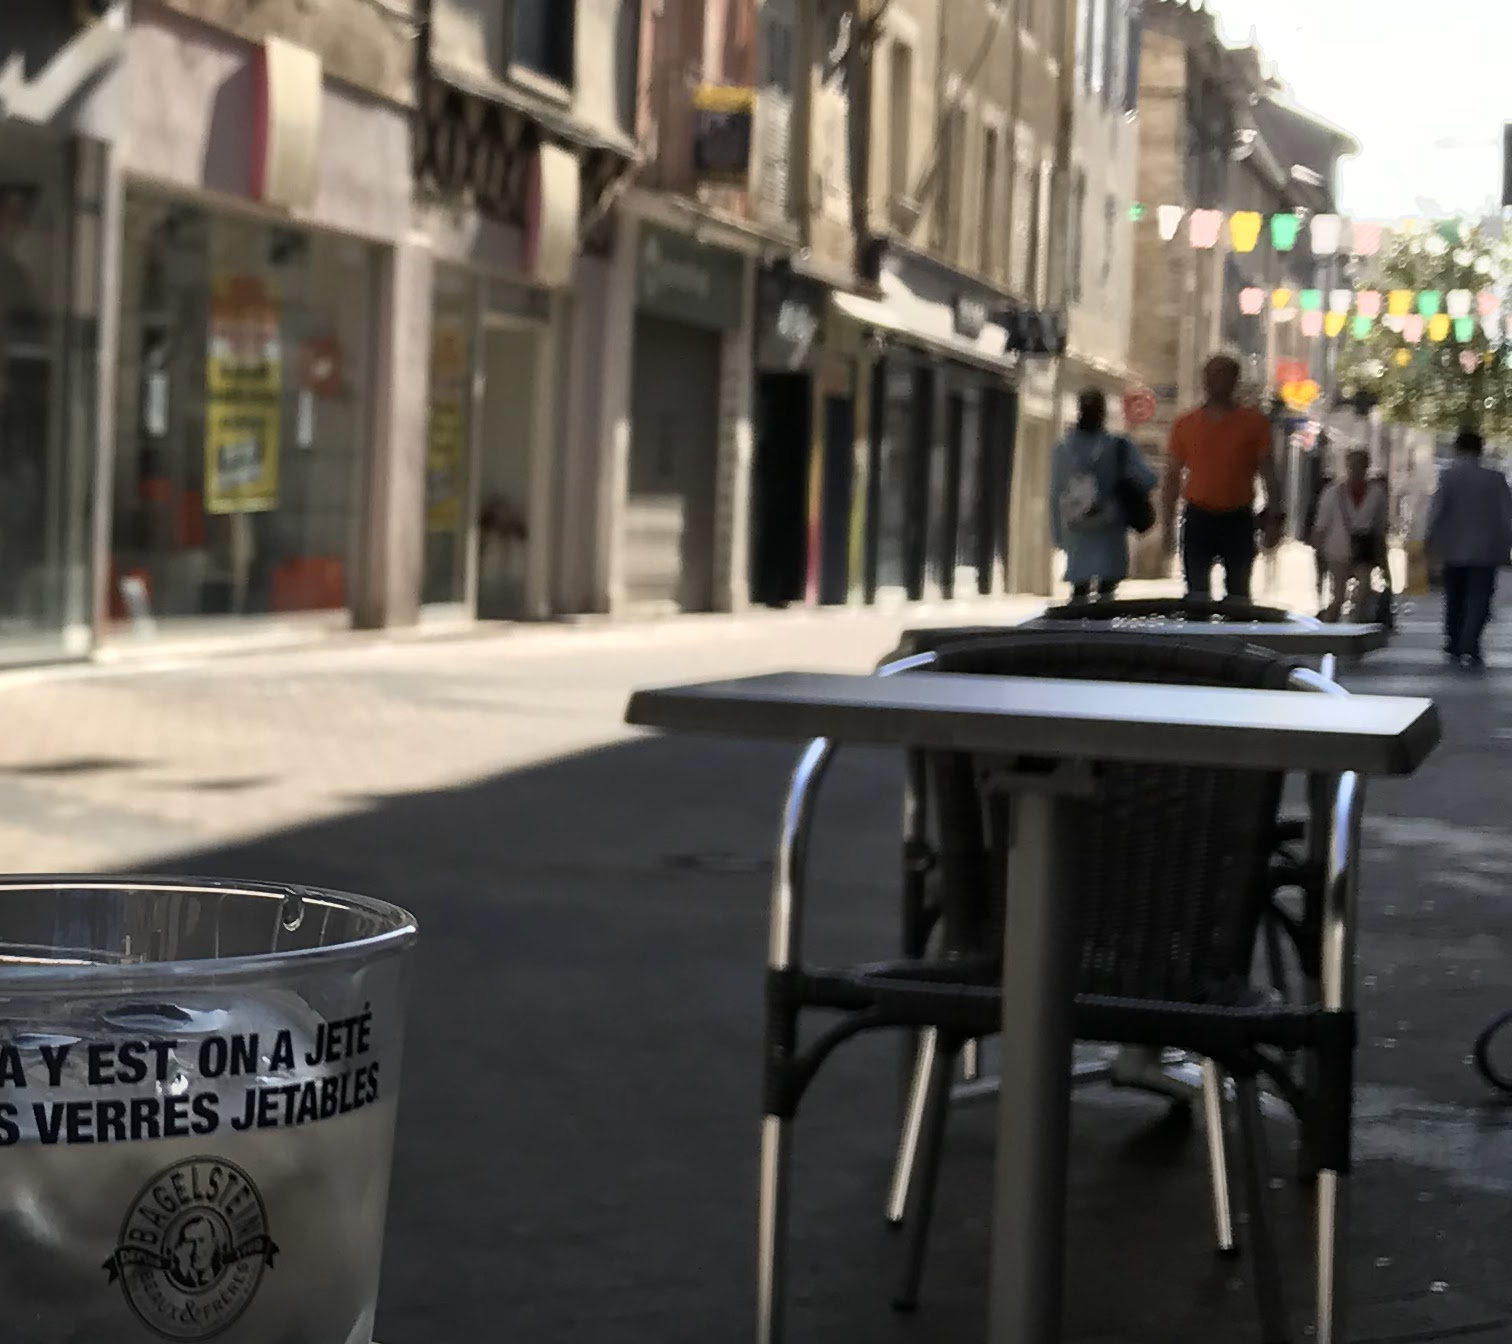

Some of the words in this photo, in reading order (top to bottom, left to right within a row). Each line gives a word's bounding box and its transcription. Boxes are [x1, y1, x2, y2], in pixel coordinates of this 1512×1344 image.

[35, 1043, 71, 1087] Y
[88, 1041, 178, 1085] EST
[197, 1032, 260, 1079] ON
[269, 1029, 296, 1072] A
[304, 1001, 373, 1067] JETÉ
[32, 1092, 220, 1145] VERRES
[230, 1060, 381, 1131] JETABLES
[128, 1164, 263, 1245] BAGELSTEIN
